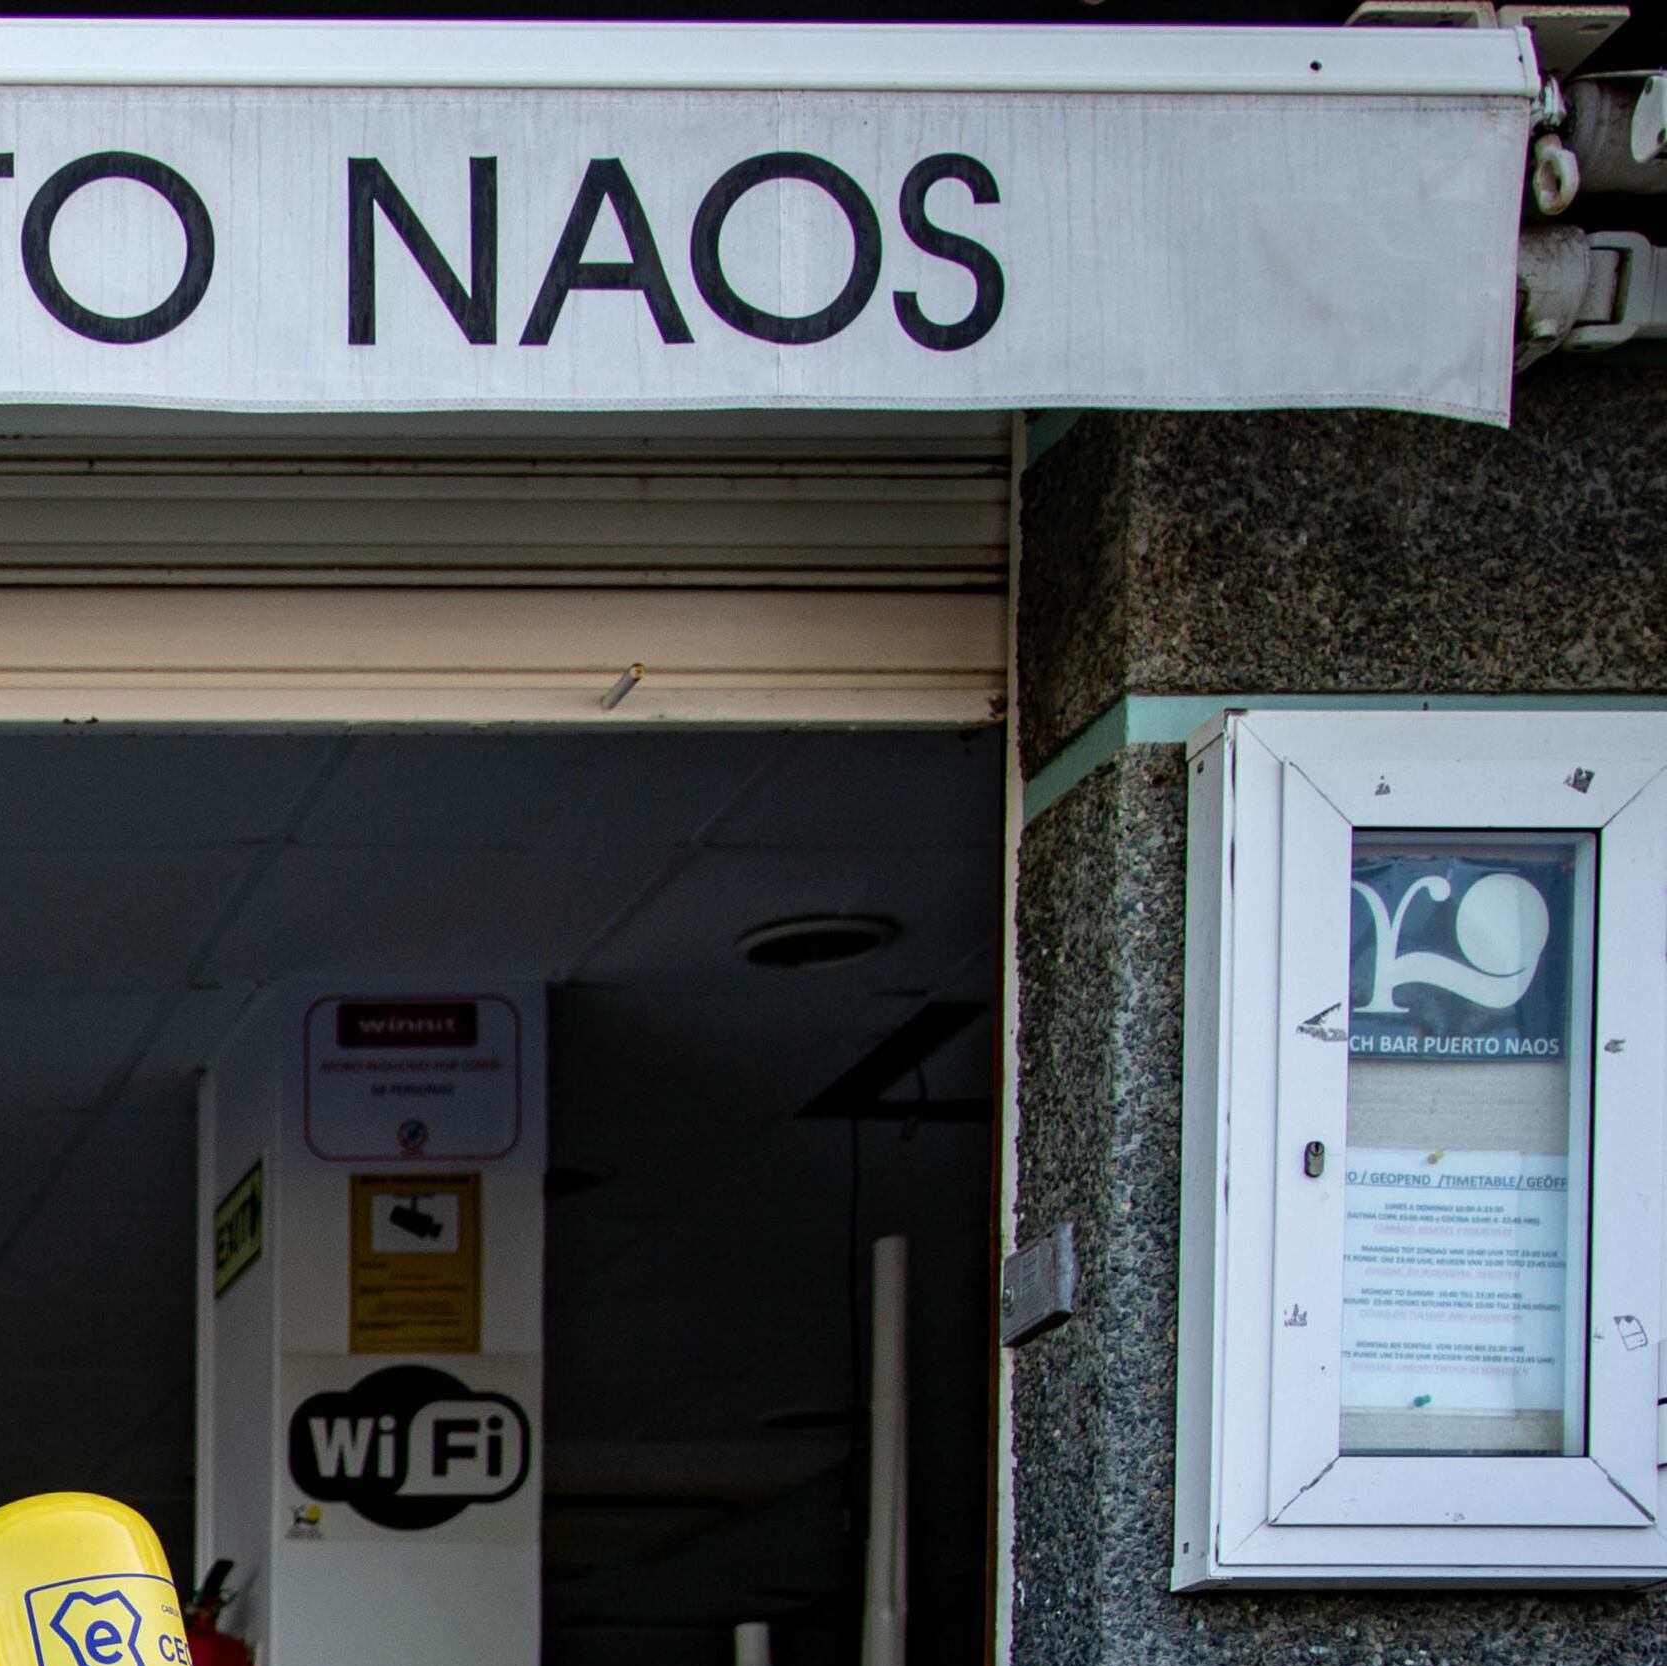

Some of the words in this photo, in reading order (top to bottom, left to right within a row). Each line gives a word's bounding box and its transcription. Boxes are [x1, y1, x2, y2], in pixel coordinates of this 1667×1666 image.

[348, 150, 1004, 351] NAOS
[357, 1013, 460, 1034] winnit
[1380, 1035, 1417, 1053] BAR
[1424, 1036, 1500, 1055] PUERTO
[1506, 1037, 1560, 1056] NAOS
[1370, 1171, 1431, 1186] GEOPEND
